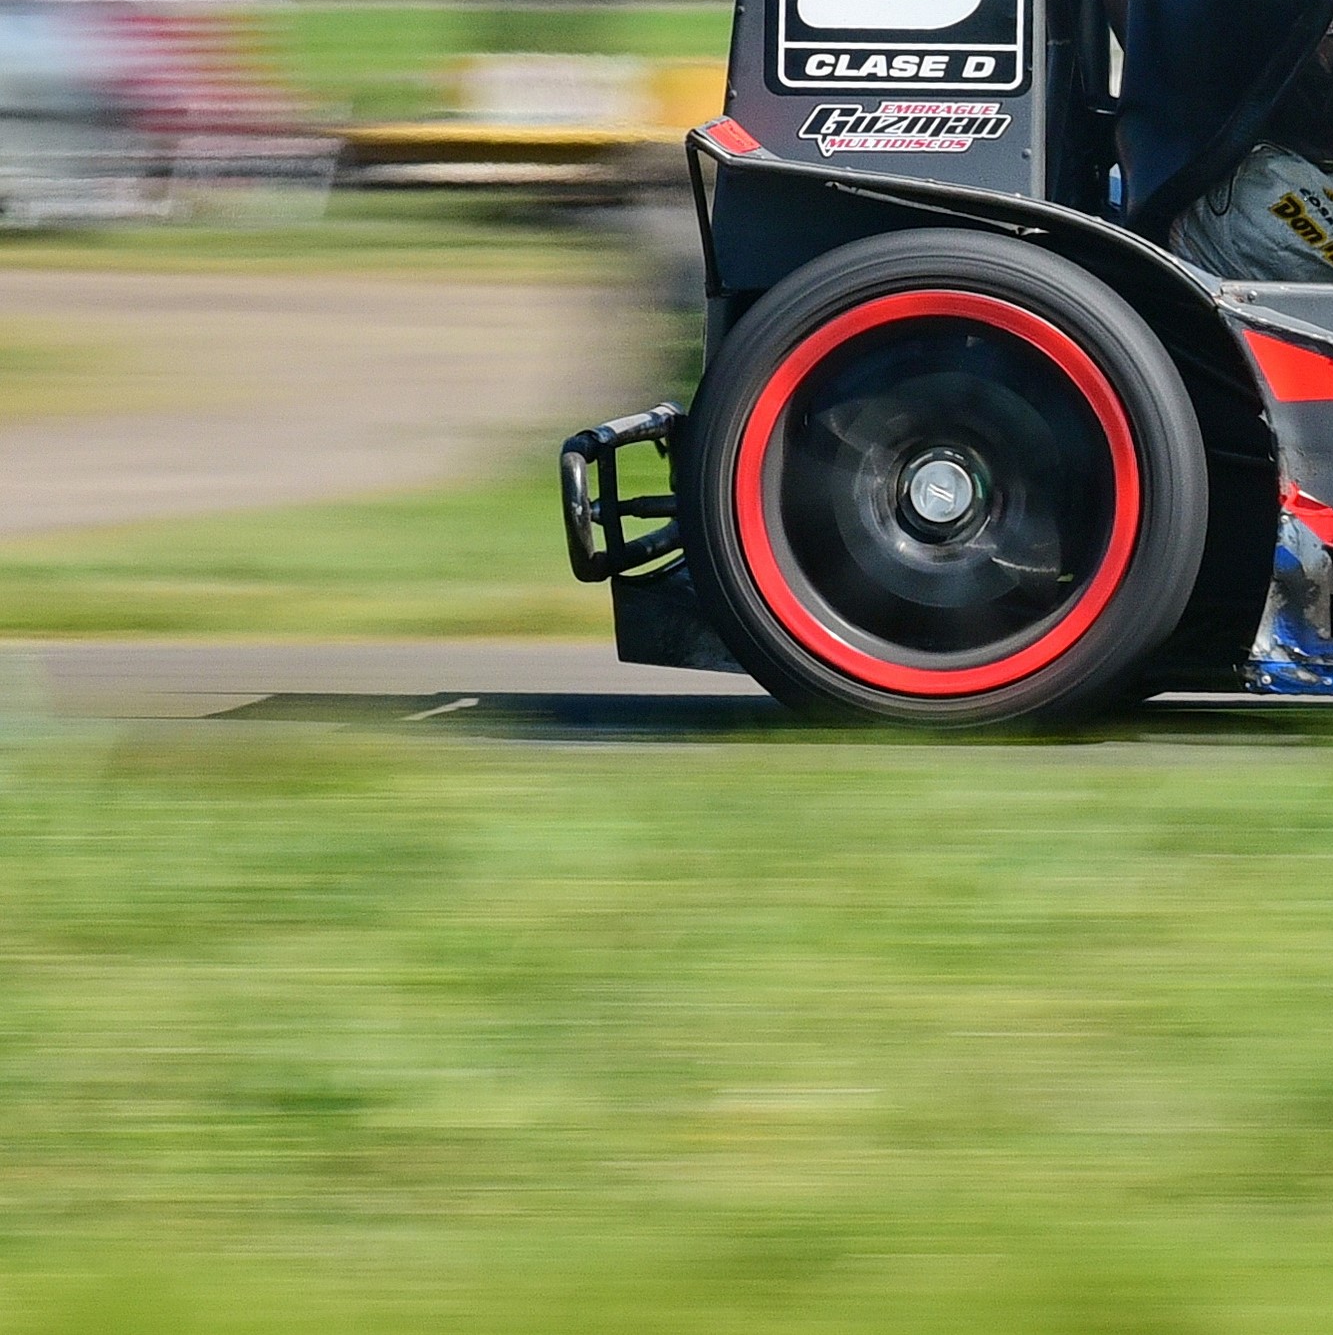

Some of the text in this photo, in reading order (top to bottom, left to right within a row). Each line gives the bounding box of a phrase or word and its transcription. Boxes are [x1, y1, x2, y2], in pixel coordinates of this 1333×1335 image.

[805, 54, 996, 78] CLASE D
[880, 104, 995, 115] EMBRAGUE
[826, 138, 968, 149] MULTIDISCOS
[1270, 194, 1324, 244] Don
